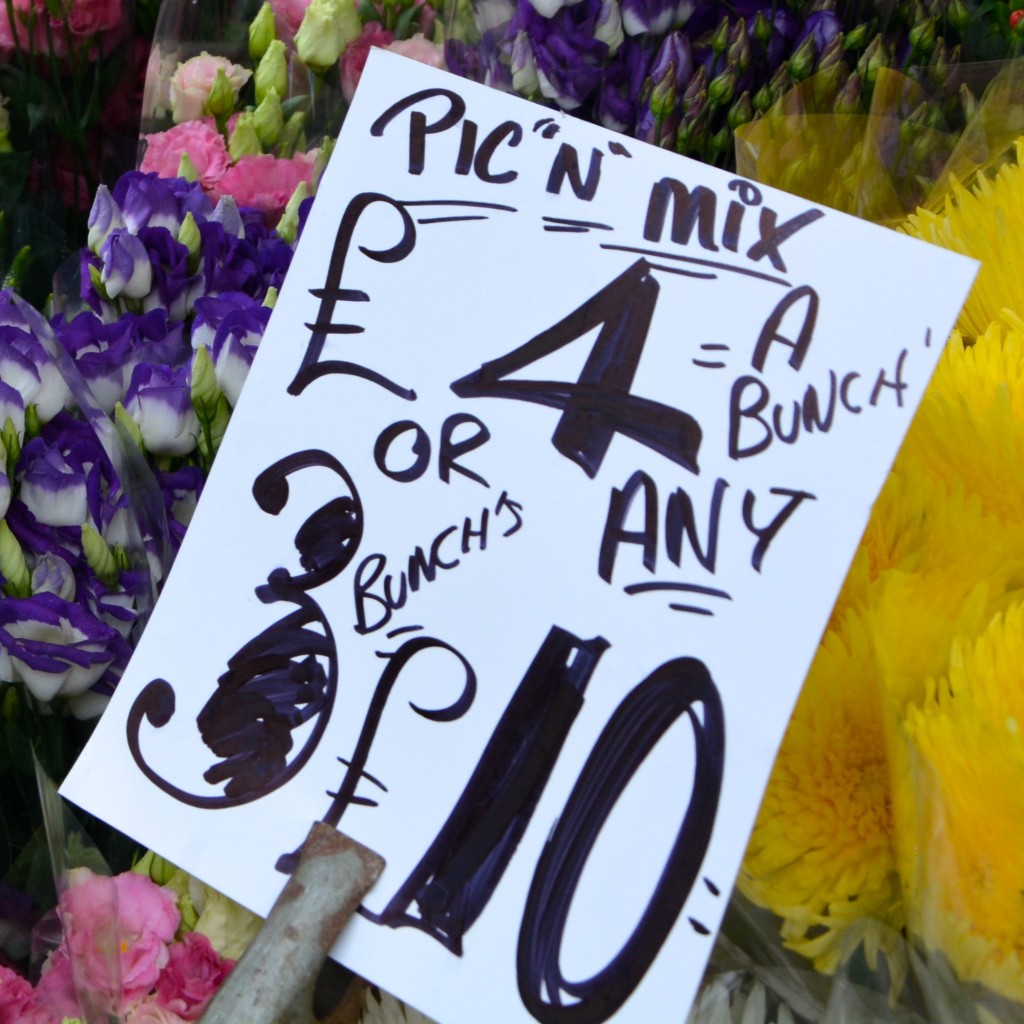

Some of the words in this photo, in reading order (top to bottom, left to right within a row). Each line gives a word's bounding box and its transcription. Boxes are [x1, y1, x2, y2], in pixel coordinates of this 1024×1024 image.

[375, 412, 490, 488] OR
[597, 470, 815, 583] ANY
[127, 449, 363, 808] 3
